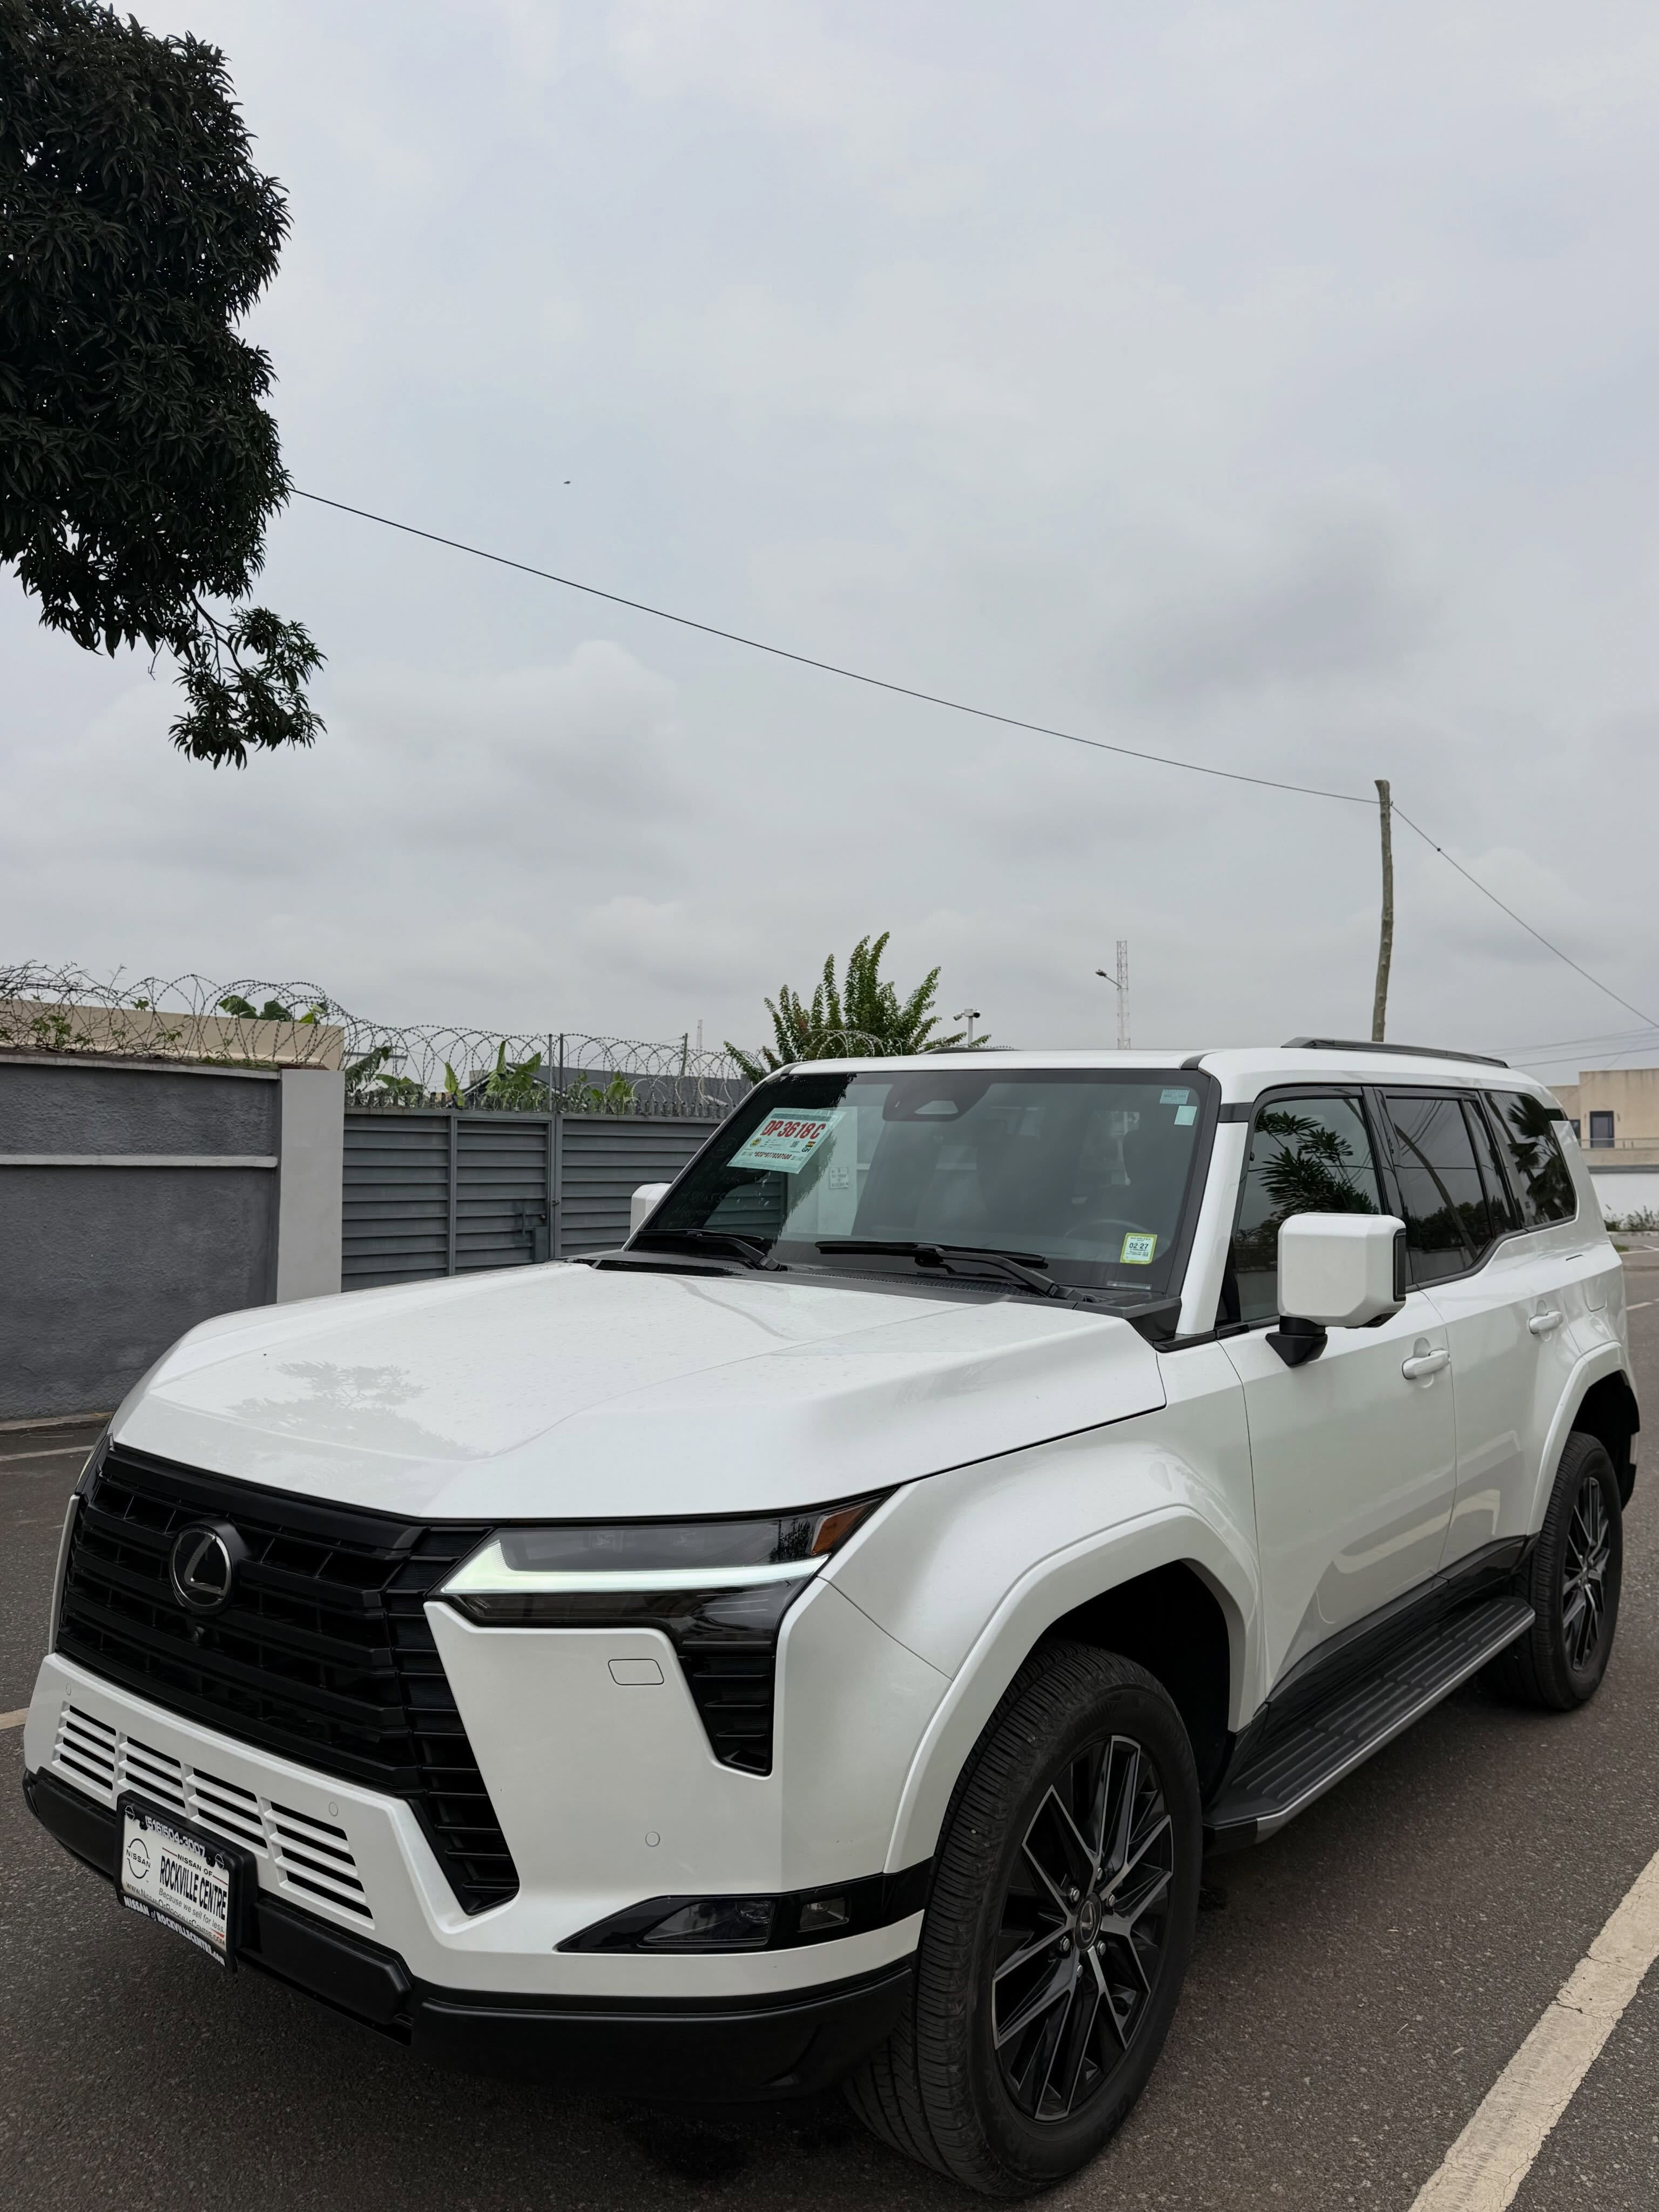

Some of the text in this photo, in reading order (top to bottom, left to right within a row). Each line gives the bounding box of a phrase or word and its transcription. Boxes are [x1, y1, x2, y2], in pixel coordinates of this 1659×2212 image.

[760, 1120, 826, 1139] DP 3618 C
[126, 1849, 151, 1868] NISSAN
[178, 1853, 201, 1871] NISSAN
[204, 1869, 213, 1877] OF
[160, 1855, 227, 1920] ROCKVILLE CENTRE
[123, 1896, 150, 1917] NISSAN
[151, 1911, 157, 1921] of
[159, 1888, 182, 1906] Because
[184, 1904, 191, 1912] we
[192, 1909, 202, 1919] sell
[203, 1914, 211, 1924] for
